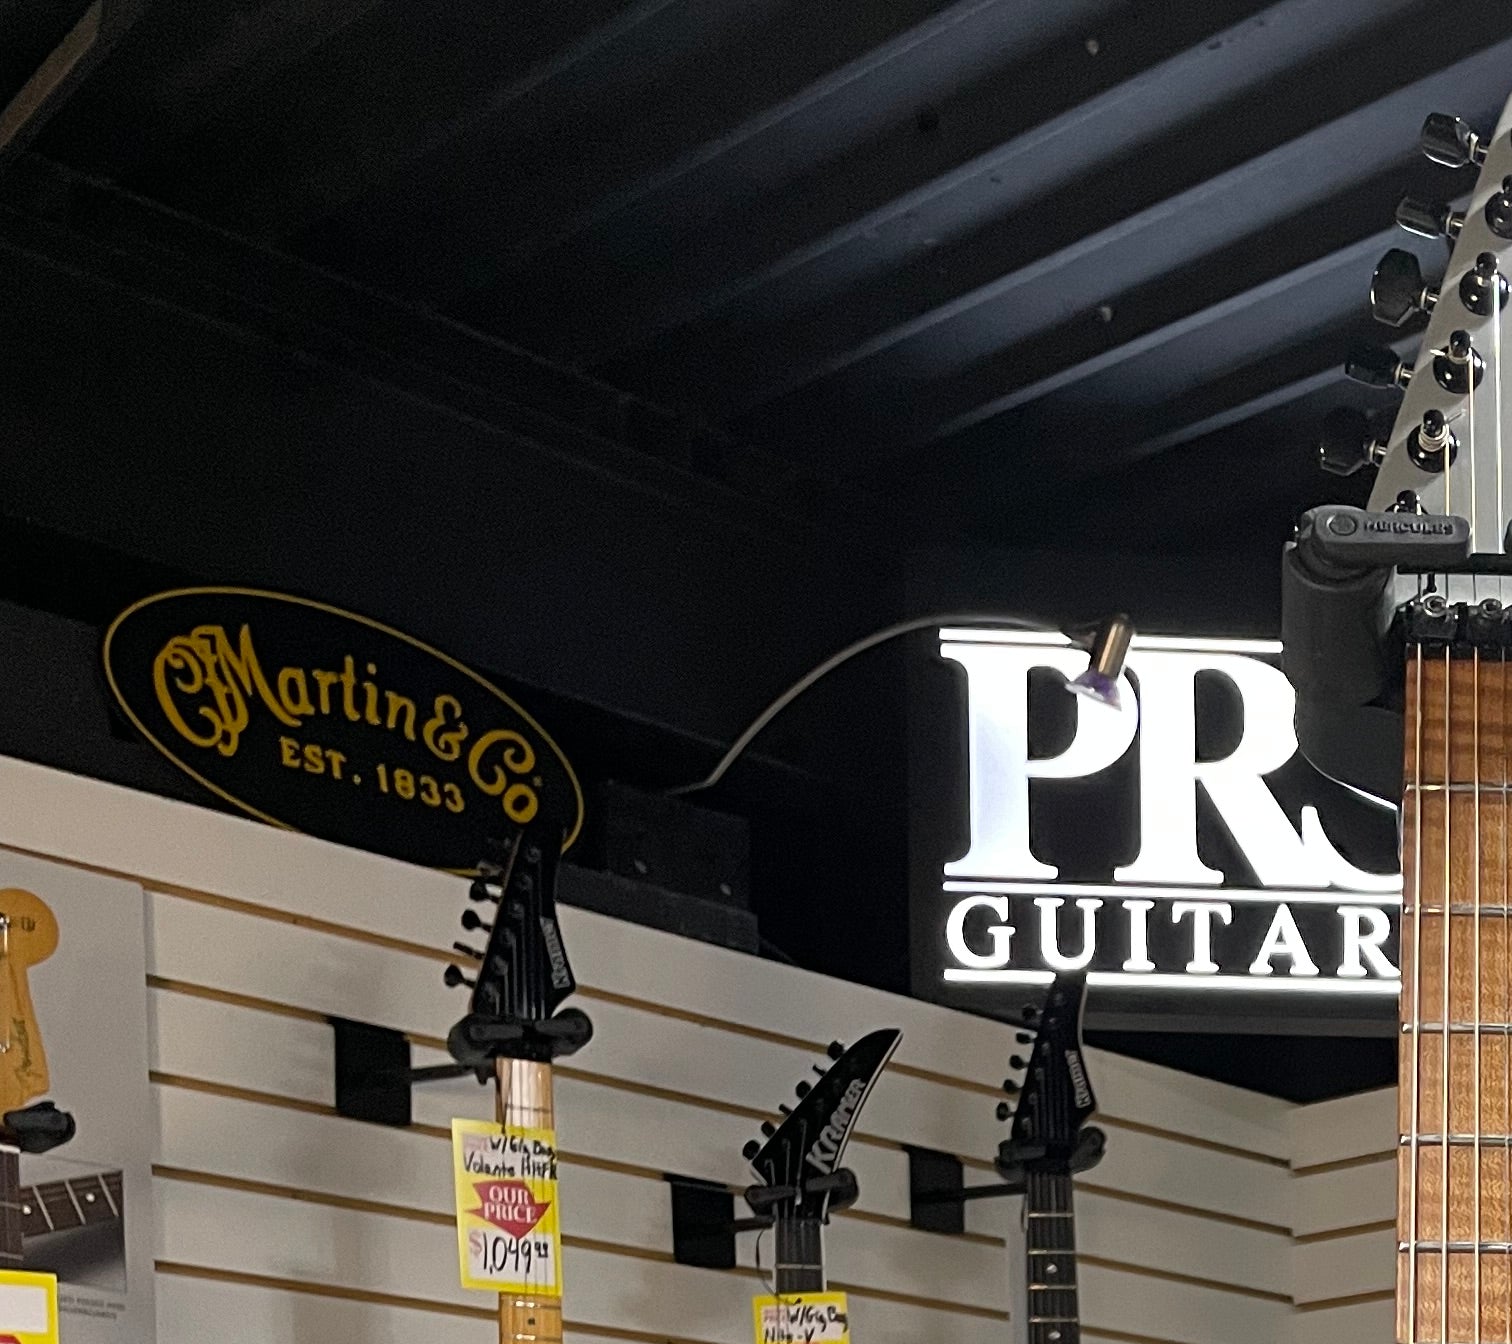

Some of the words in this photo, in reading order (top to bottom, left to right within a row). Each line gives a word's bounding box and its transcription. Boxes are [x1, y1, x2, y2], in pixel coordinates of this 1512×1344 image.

[376, 763, 465, 814] 1833
[946, 895, 1401, 977] GUITAR
[484, 1202, 538, 1224] PRICE
[489, 1185, 529, 1206] OUR
